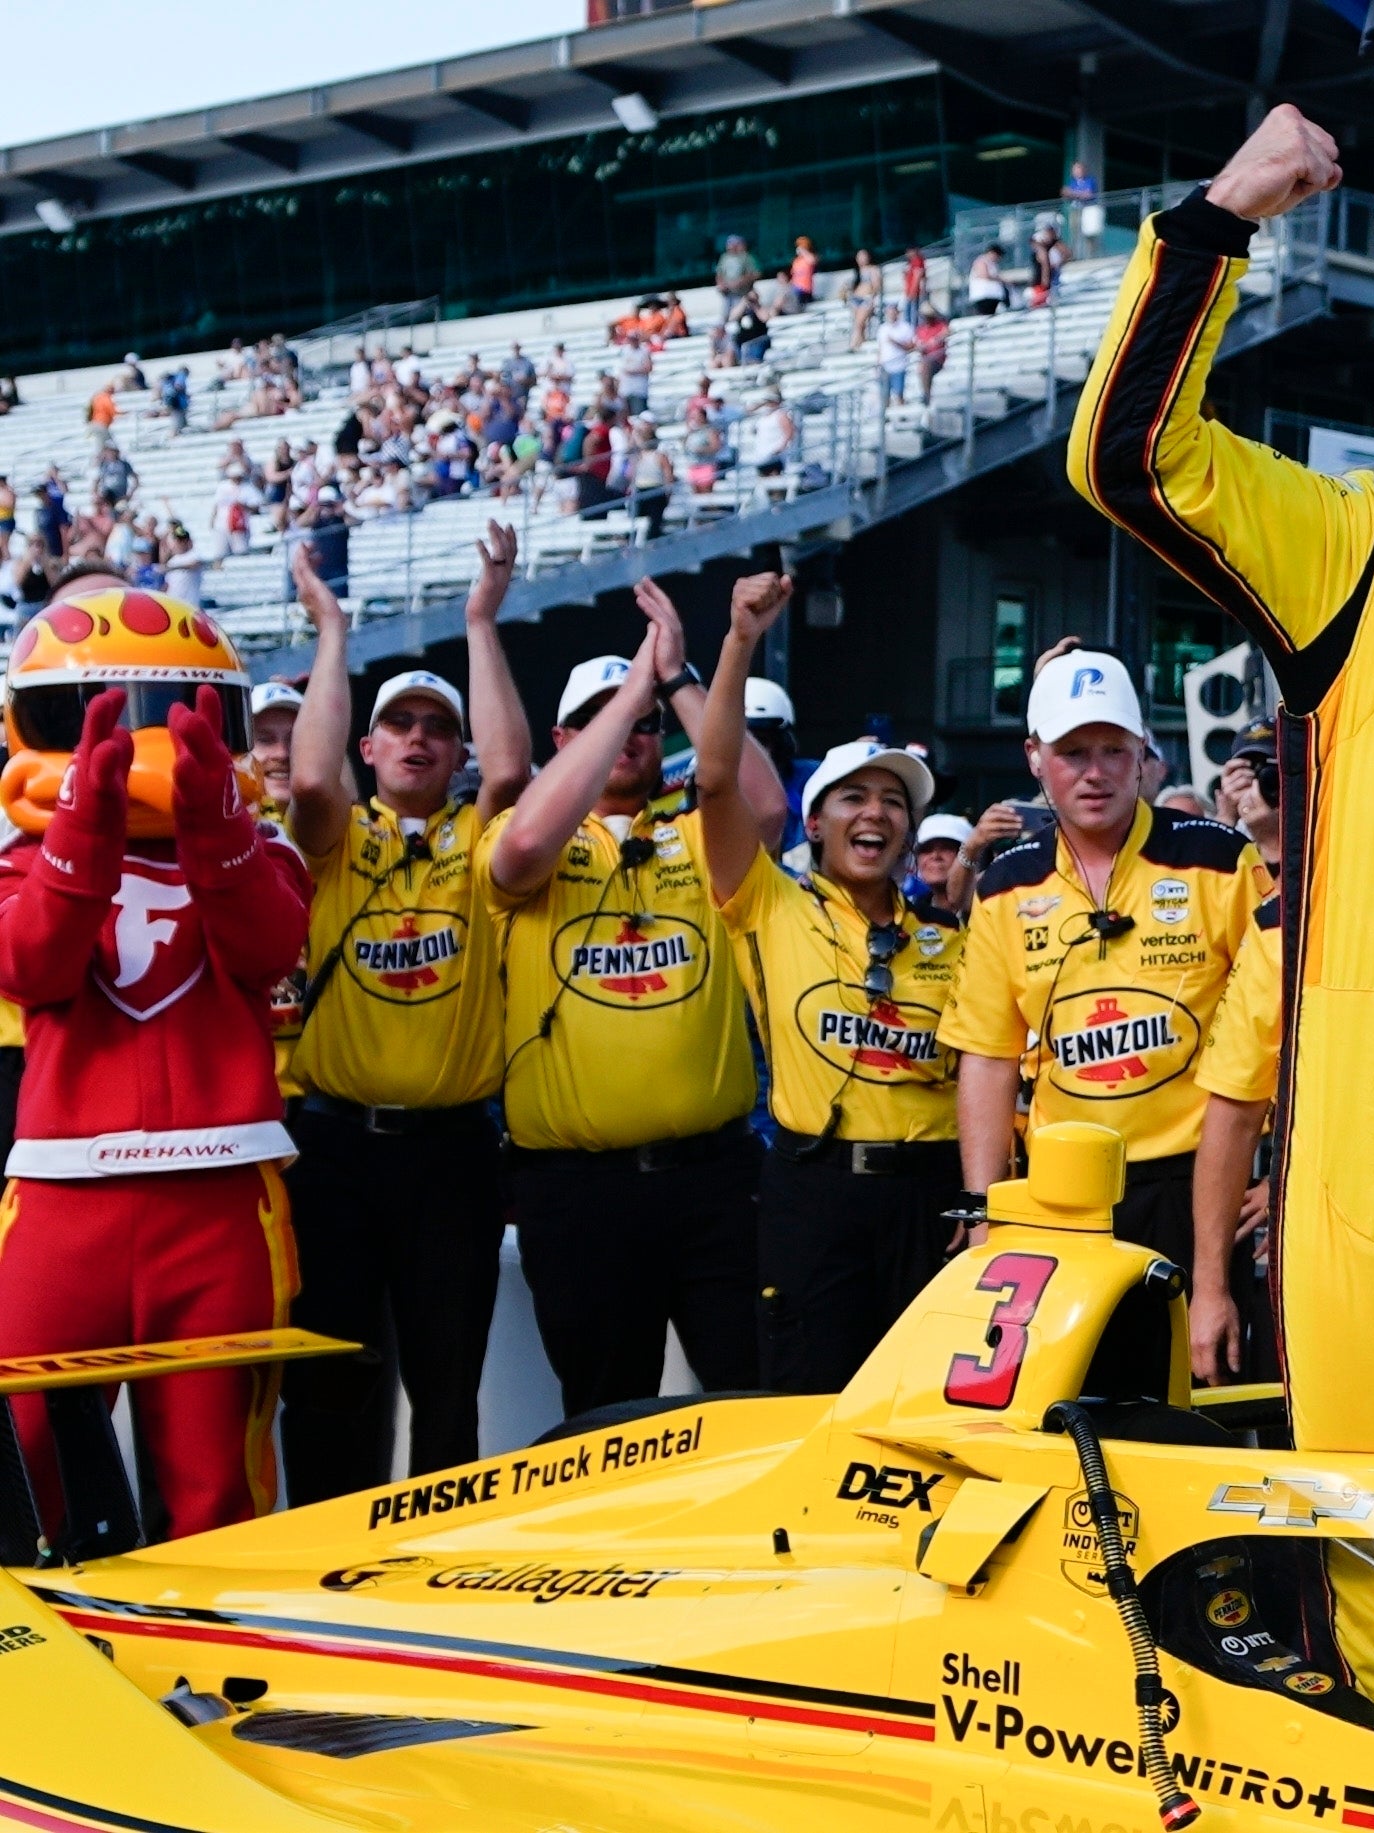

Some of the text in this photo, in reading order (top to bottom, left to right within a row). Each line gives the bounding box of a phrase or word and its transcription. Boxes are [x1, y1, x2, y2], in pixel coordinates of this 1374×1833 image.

[82, 668, 225, 681] FIREHAWK
[355, 928, 460, 970] PENNZOIL
[573, 935, 690, 976] PENNZOIL
[1141, 951, 1206, 966] HITACHI
[1053, 1015, 1175, 1067] ENNZOIL
[98, 1143, 236, 1160] FIREHAWK
[944, 1252, 1059, 1410] 3
[368, 1417, 704, 1531] PENSKE Truck Rental
[836, 1461, 946, 1512] DEX
[427, 1561, 681, 1604] Gallagher
[1244, 1632, 1276, 1648] NTT
[942, 1653, 1020, 1697] Shell
